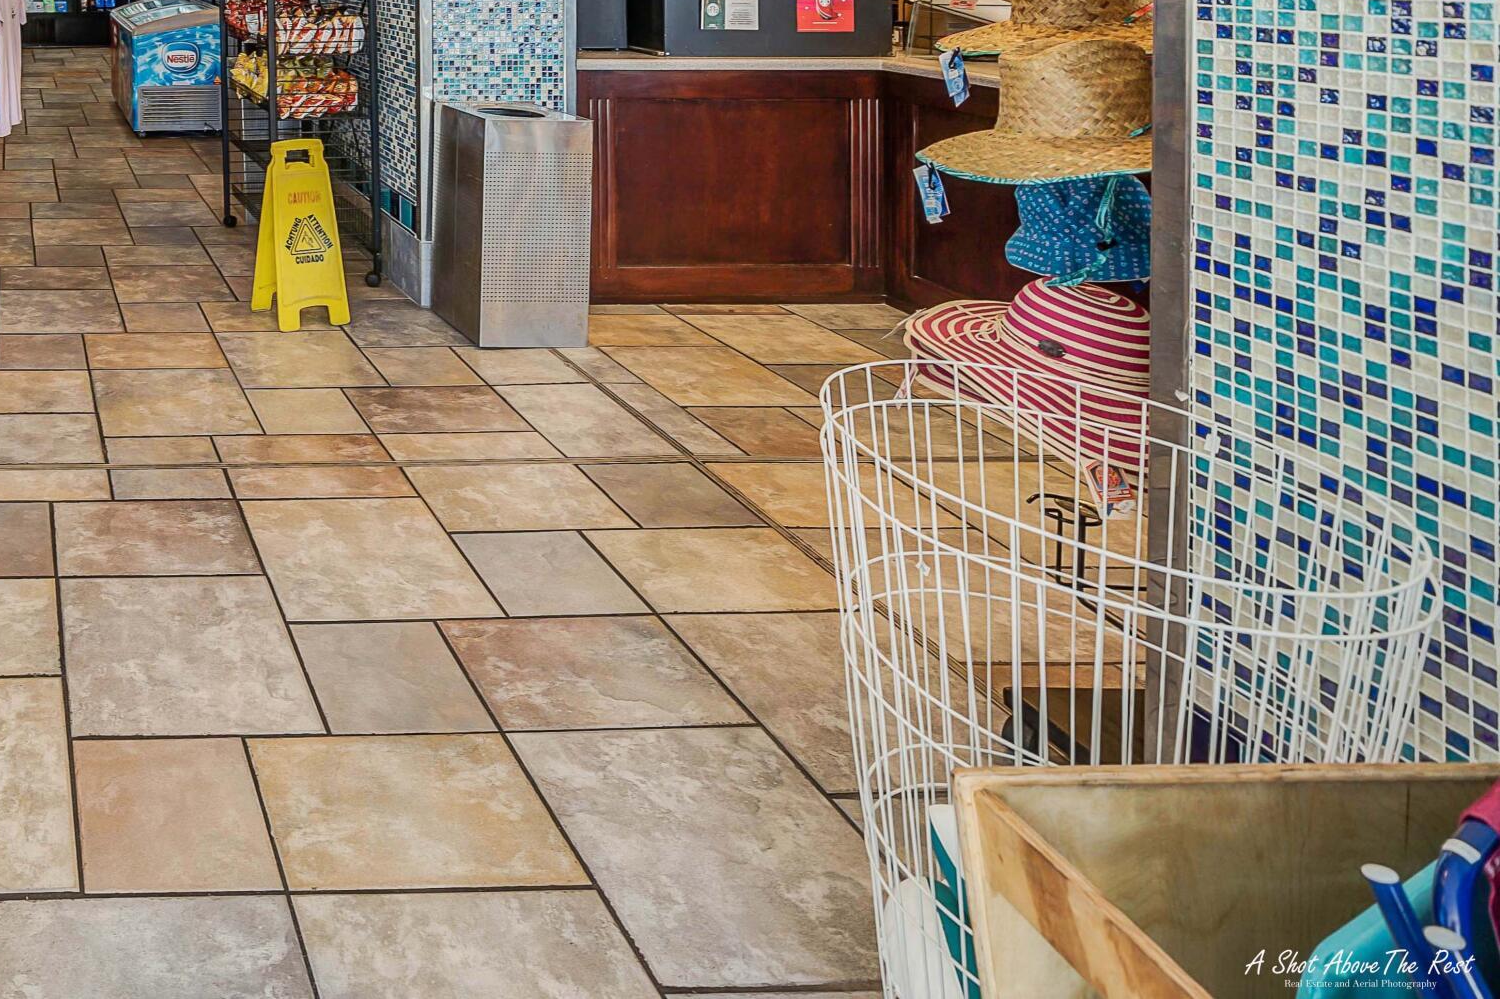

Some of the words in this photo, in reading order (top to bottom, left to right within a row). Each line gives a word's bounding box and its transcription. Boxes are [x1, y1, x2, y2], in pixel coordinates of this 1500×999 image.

[288, 191, 321, 204] CAUTION
[285, 217, 301, 250] ACHTUNG
[307, 214, 333, 248] ATTENTION
[295, 253, 325, 265] CUIDADO
